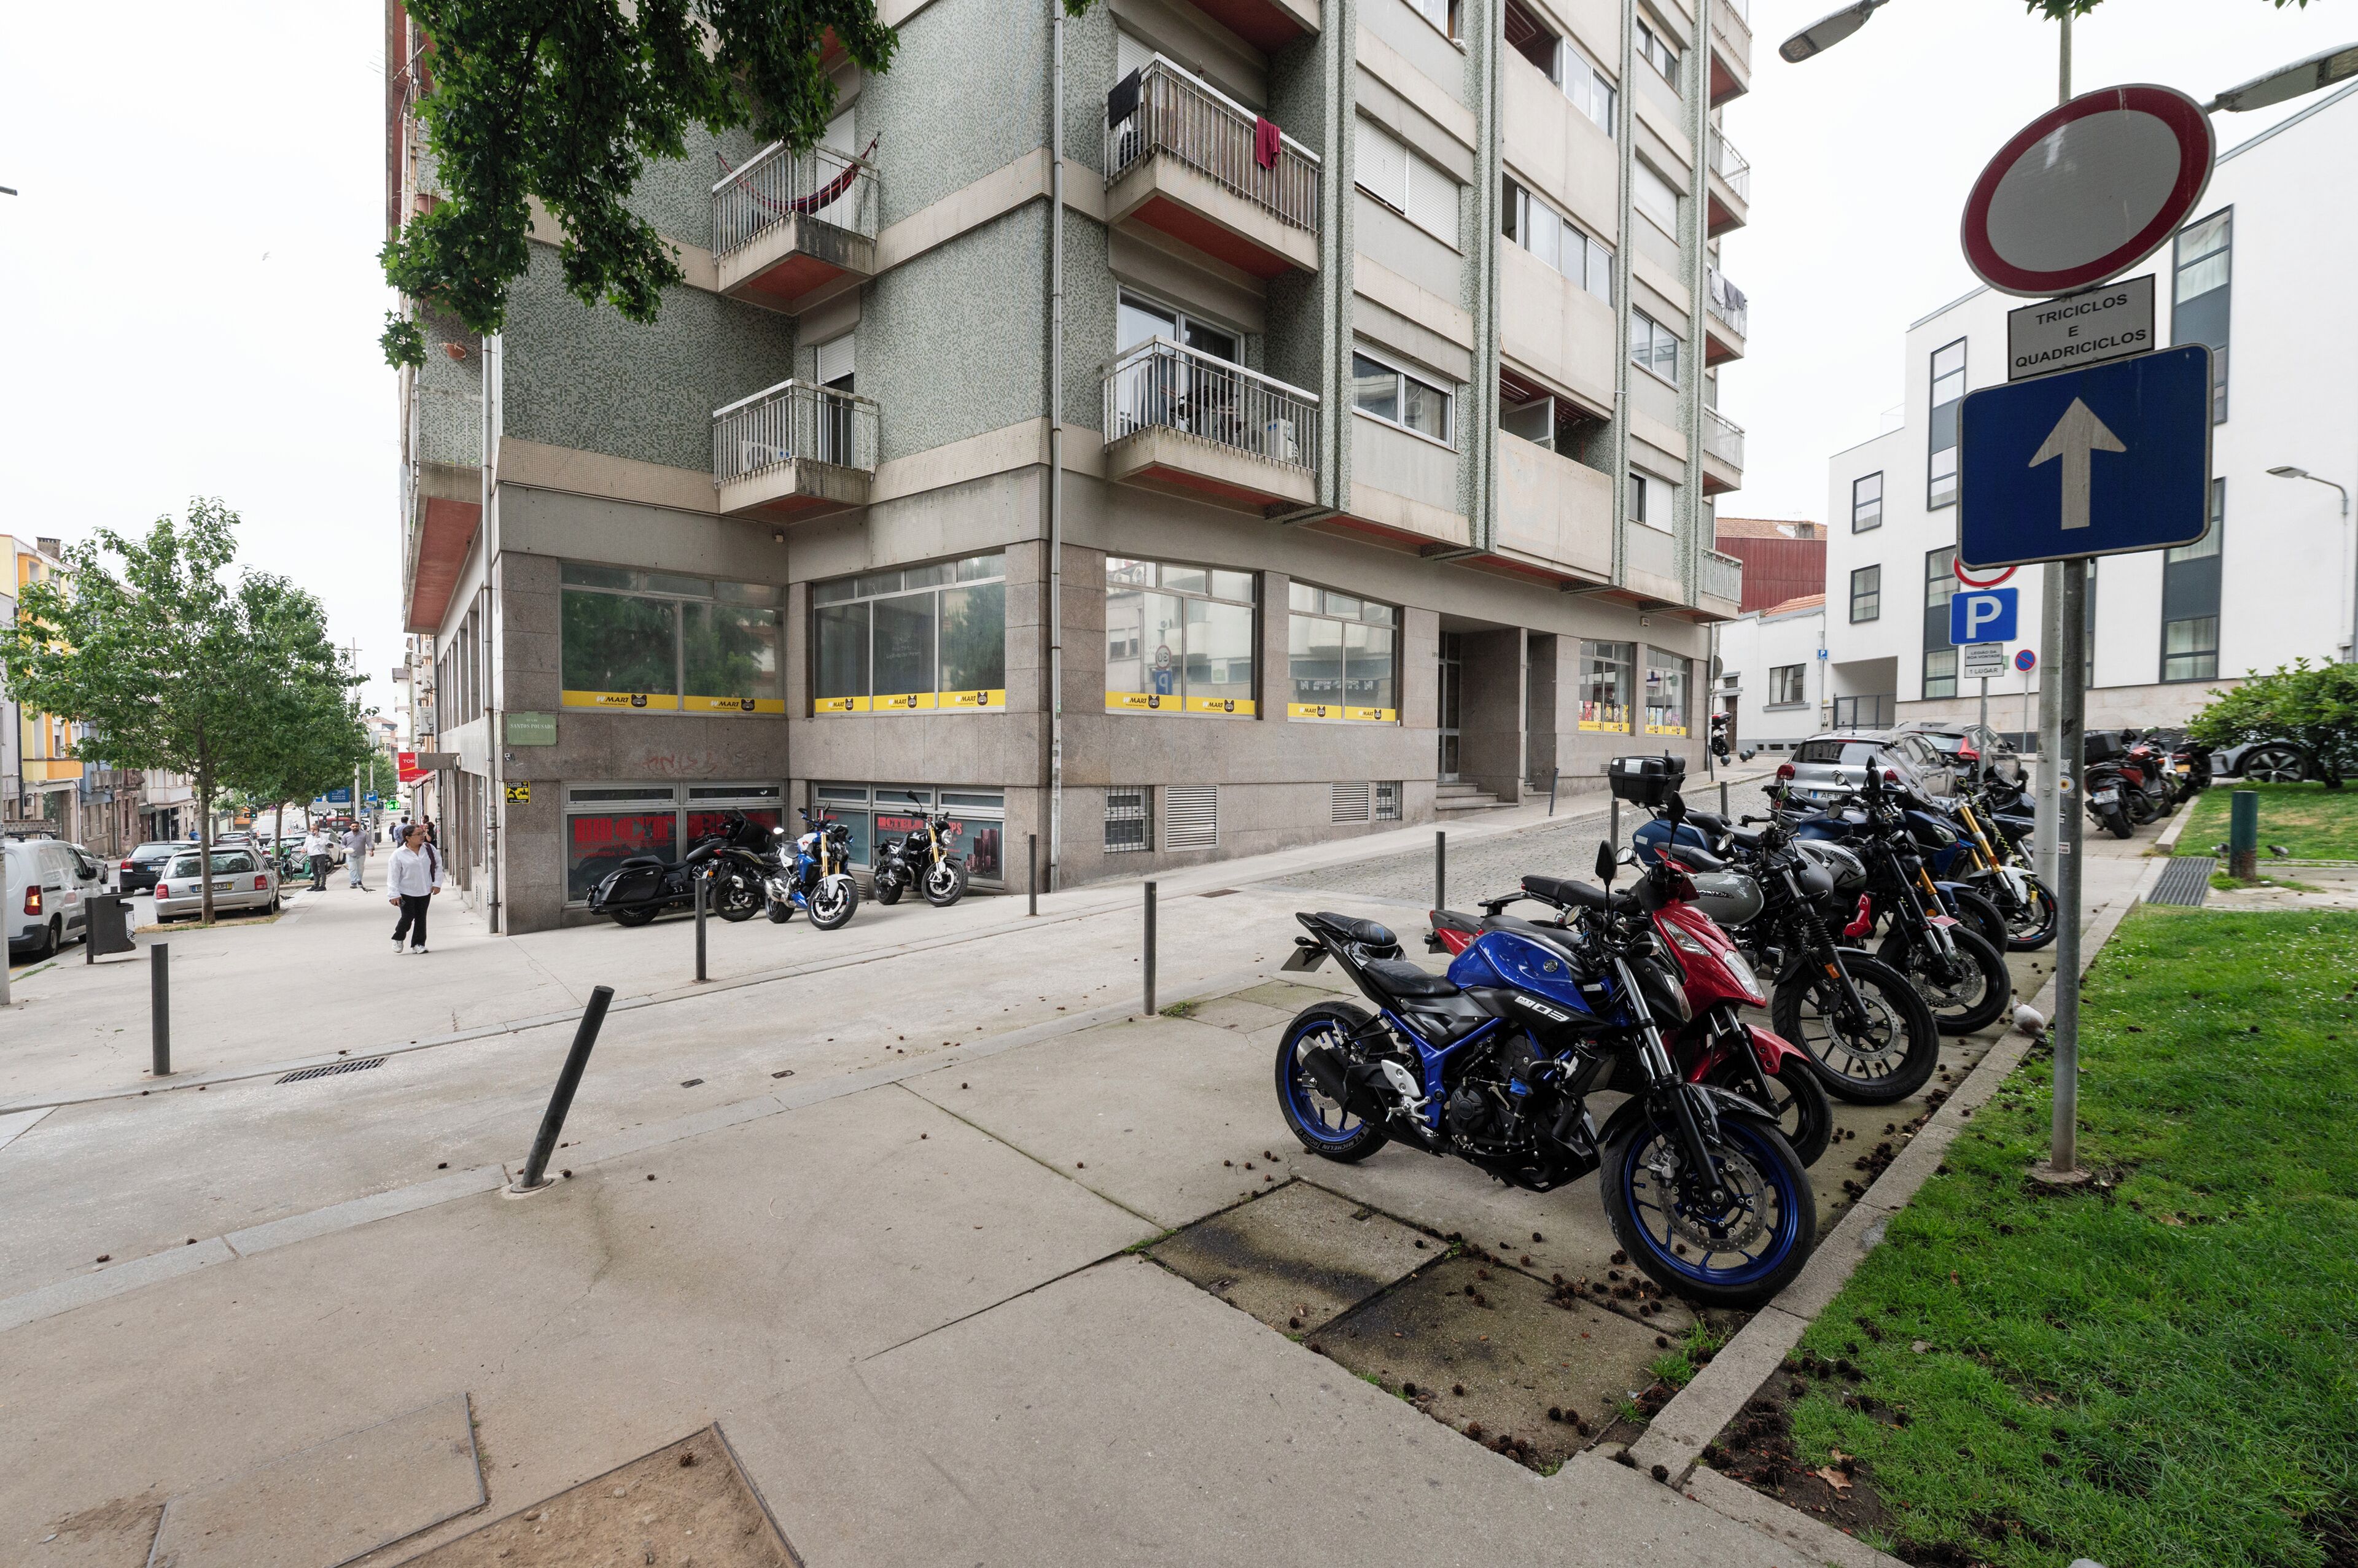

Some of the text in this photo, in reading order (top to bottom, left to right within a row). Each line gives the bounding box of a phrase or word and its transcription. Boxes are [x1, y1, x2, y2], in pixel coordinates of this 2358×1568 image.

[2036, 294, 2127, 324] TRICICLOS
[2069, 326, 2079, 337] E
[2015, 330, 2146, 367] QUADRICICLOS
[1966, 596, 2002, 639] P
[1829, 850, 1861, 871] TRIUMPH
[1531, 1003, 1570, 1022] 03
[1302, 1133, 1319, 1146] ROAD
[1321, 1140, 1355, 1151] MICHELIN
